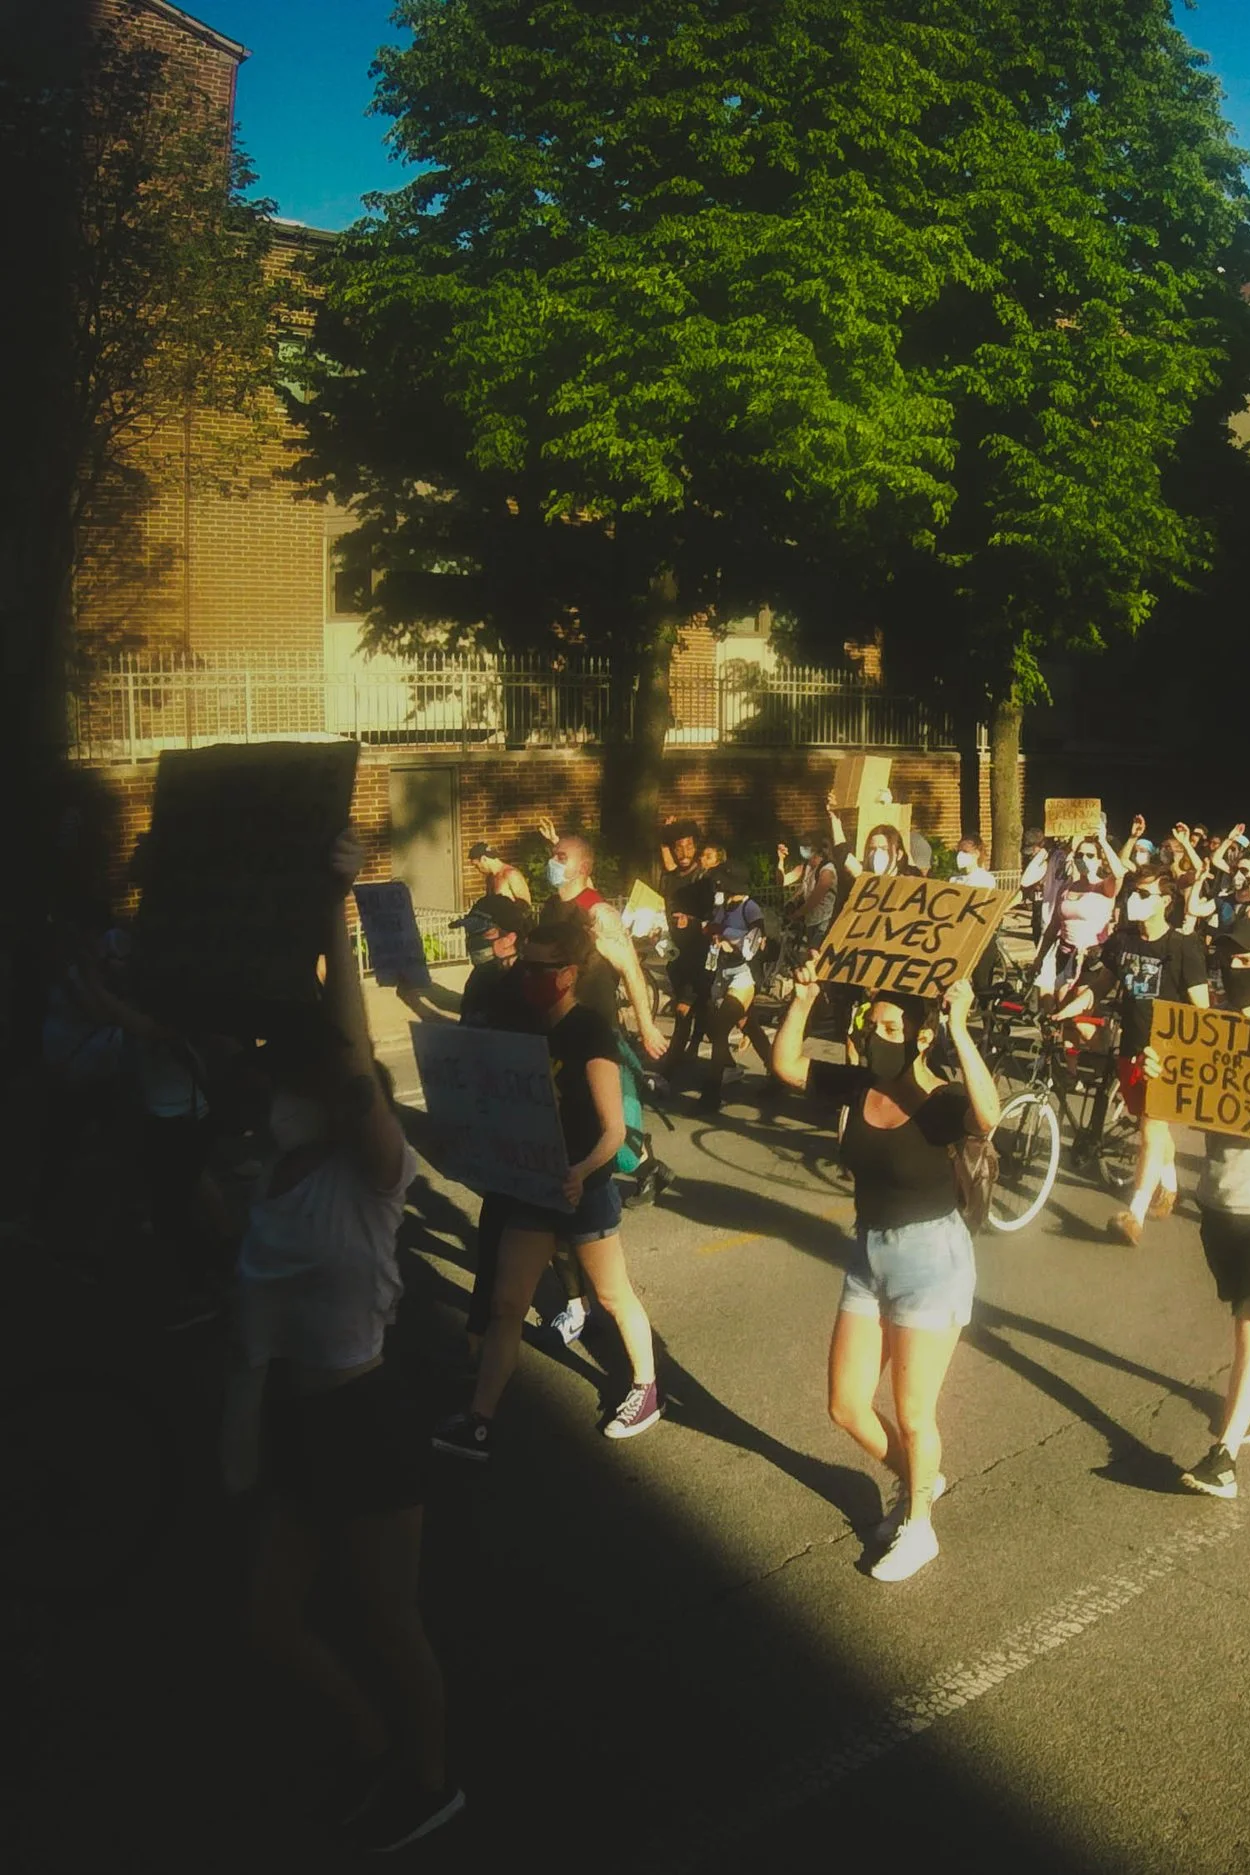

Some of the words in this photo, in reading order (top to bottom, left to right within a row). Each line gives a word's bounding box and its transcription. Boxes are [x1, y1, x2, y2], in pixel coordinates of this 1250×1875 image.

[853, 876, 996, 925] BLACK
[846, 915, 954, 954] LIVES
[815, 943, 959, 995] MATTER
[1212, 1050, 1244, 1069] FOR
